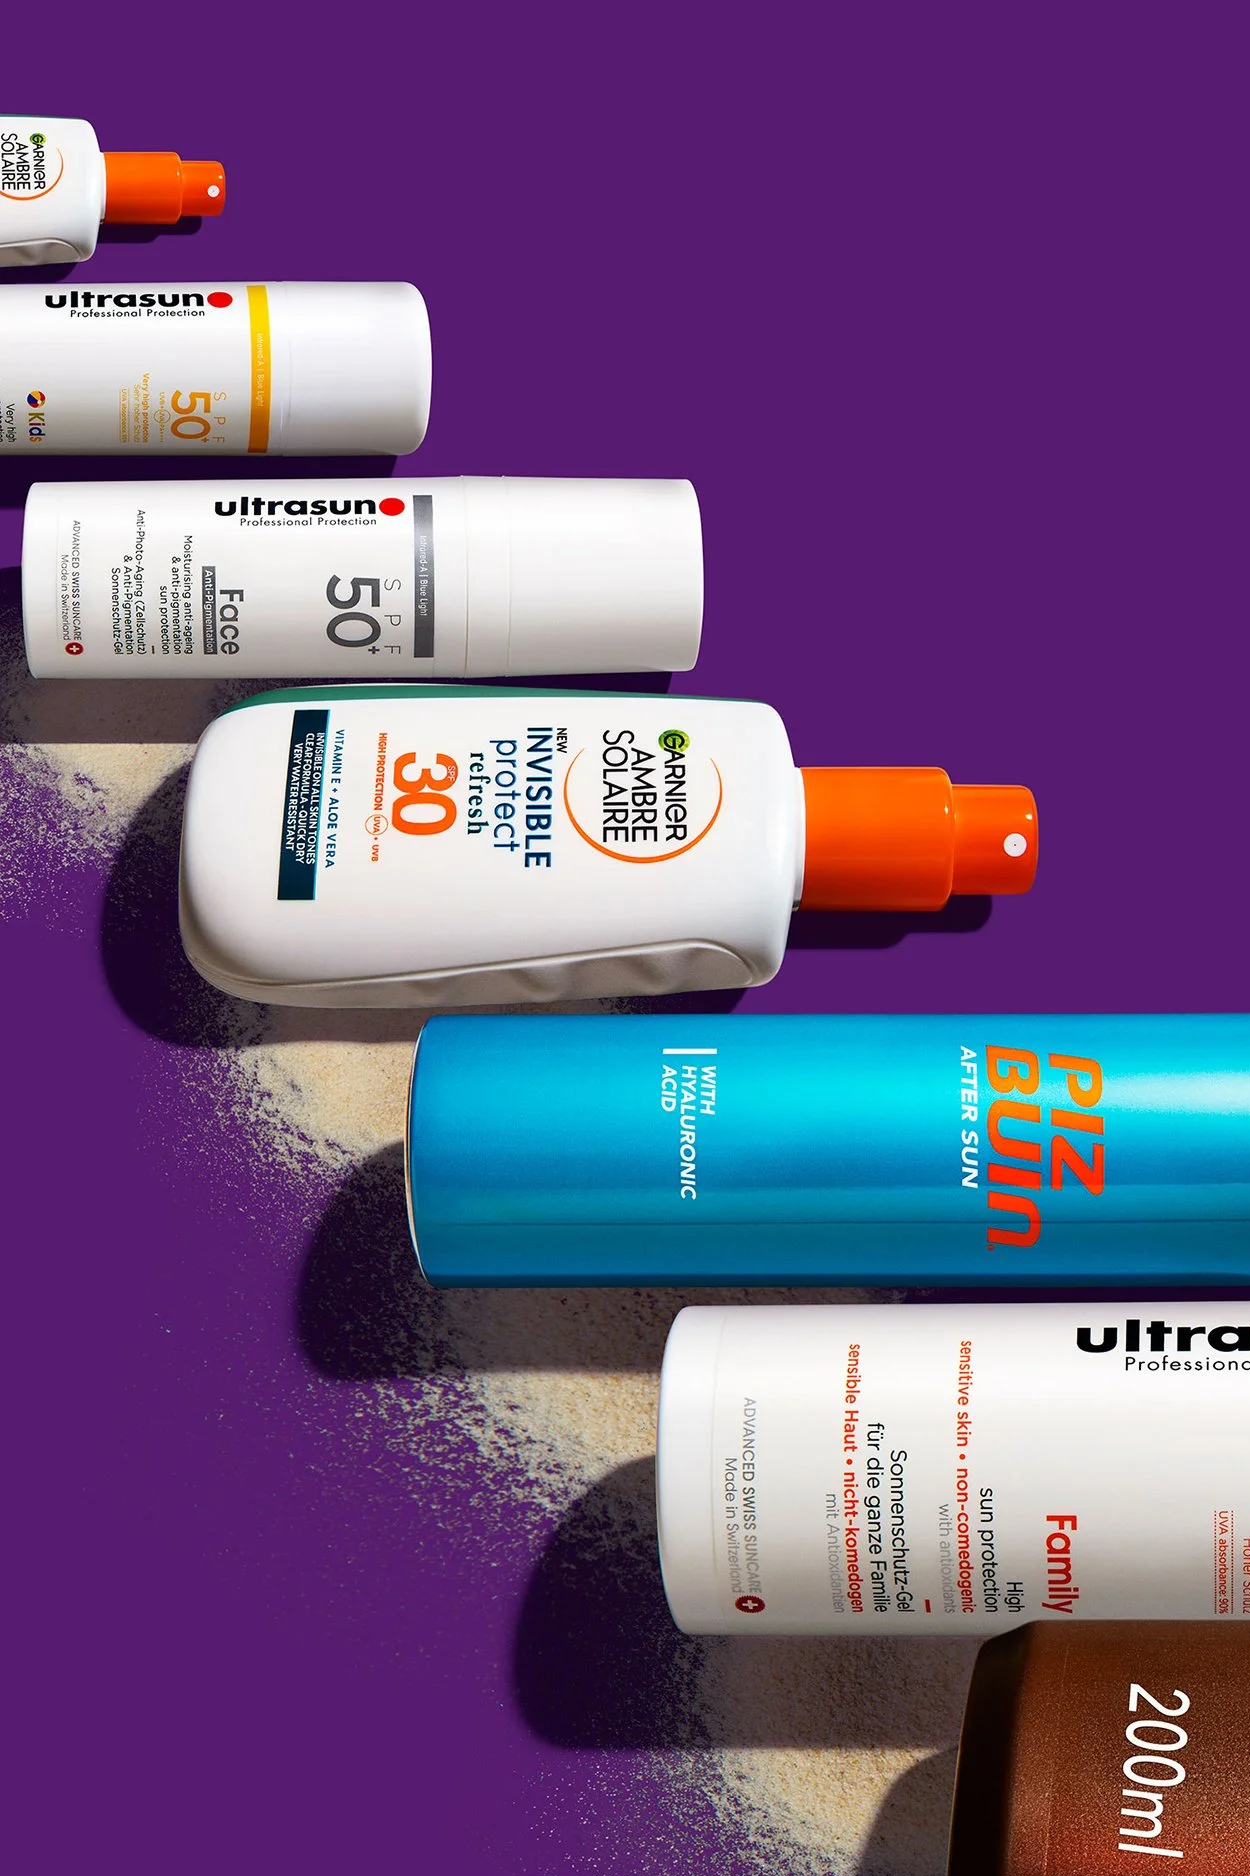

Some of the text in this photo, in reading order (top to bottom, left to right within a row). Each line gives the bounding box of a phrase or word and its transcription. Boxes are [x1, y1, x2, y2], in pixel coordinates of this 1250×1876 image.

[1, 133, 18, 190] SOLAIRE
[16, 142, 31, 190] AMBRE
[45, 291, 204, 308] ultrasun
[70, 308, 205, 318] Professional Protection
[141, 373, 150, 391] Very
[141, 393, 150, 411] high
[28, 412, 46, 443] Kids
[215, 497, 376, 517] ultrasun
[240, 517, 377, 527] Professional Protection
[159, 585, 171, 655] sun protection
[170, 556, 182, 655] & anti-pigmentation
[183, 535, 193, 655] Moisturising anti-ageing
[203, 569, 214, 653] Anti-Pigmentation
[219, 589, 244, 655] Face
[326, 574, 381, 655] 50+
[331, 729, 345, 774] VITAMIN
[374, 732, 388, 811] HIGH PROTECTION
[557, 727, 568, 753] NEW
[327, 797, 339, 829] ALOE
[392, 752, 459, 836] 30
[467, 752, 491, 835] refresh
[490, 739, 521, 852] protect
[525, 726, 553, 868] INVISIBLE
[602, 729, 635, 842] SOLAIRE
[631, 748, 658, 842] AMBRE
[325, 833, 337, 868] VERA
[660, 1064, 677, 1112] ACID
[700, 1064, 717, 1116] WITH
[960, 1045, 979, 1189] AFTER SUN
[1048, 1052, 1104, 1196] PIZ
[679, 1064, 697, 1200] HYALURONIC
[843, 1343, 864, 1613] sensible Haut nicht-komedogen
[864, 1422, 890, 1613] für die ganze Familie
[956, 1340, 977, 1614] sensitive skin non-comedogenic
[890, 1450, 915, 1613] Sonnenschutz-Gel
[978, 1488, 1001, 1613] sun protection
[1042, 1514, 1079, 1614] Family
[1004, 1581, 1025, 1613] High
[1118, 1682, 1191, 1858] 200ml
